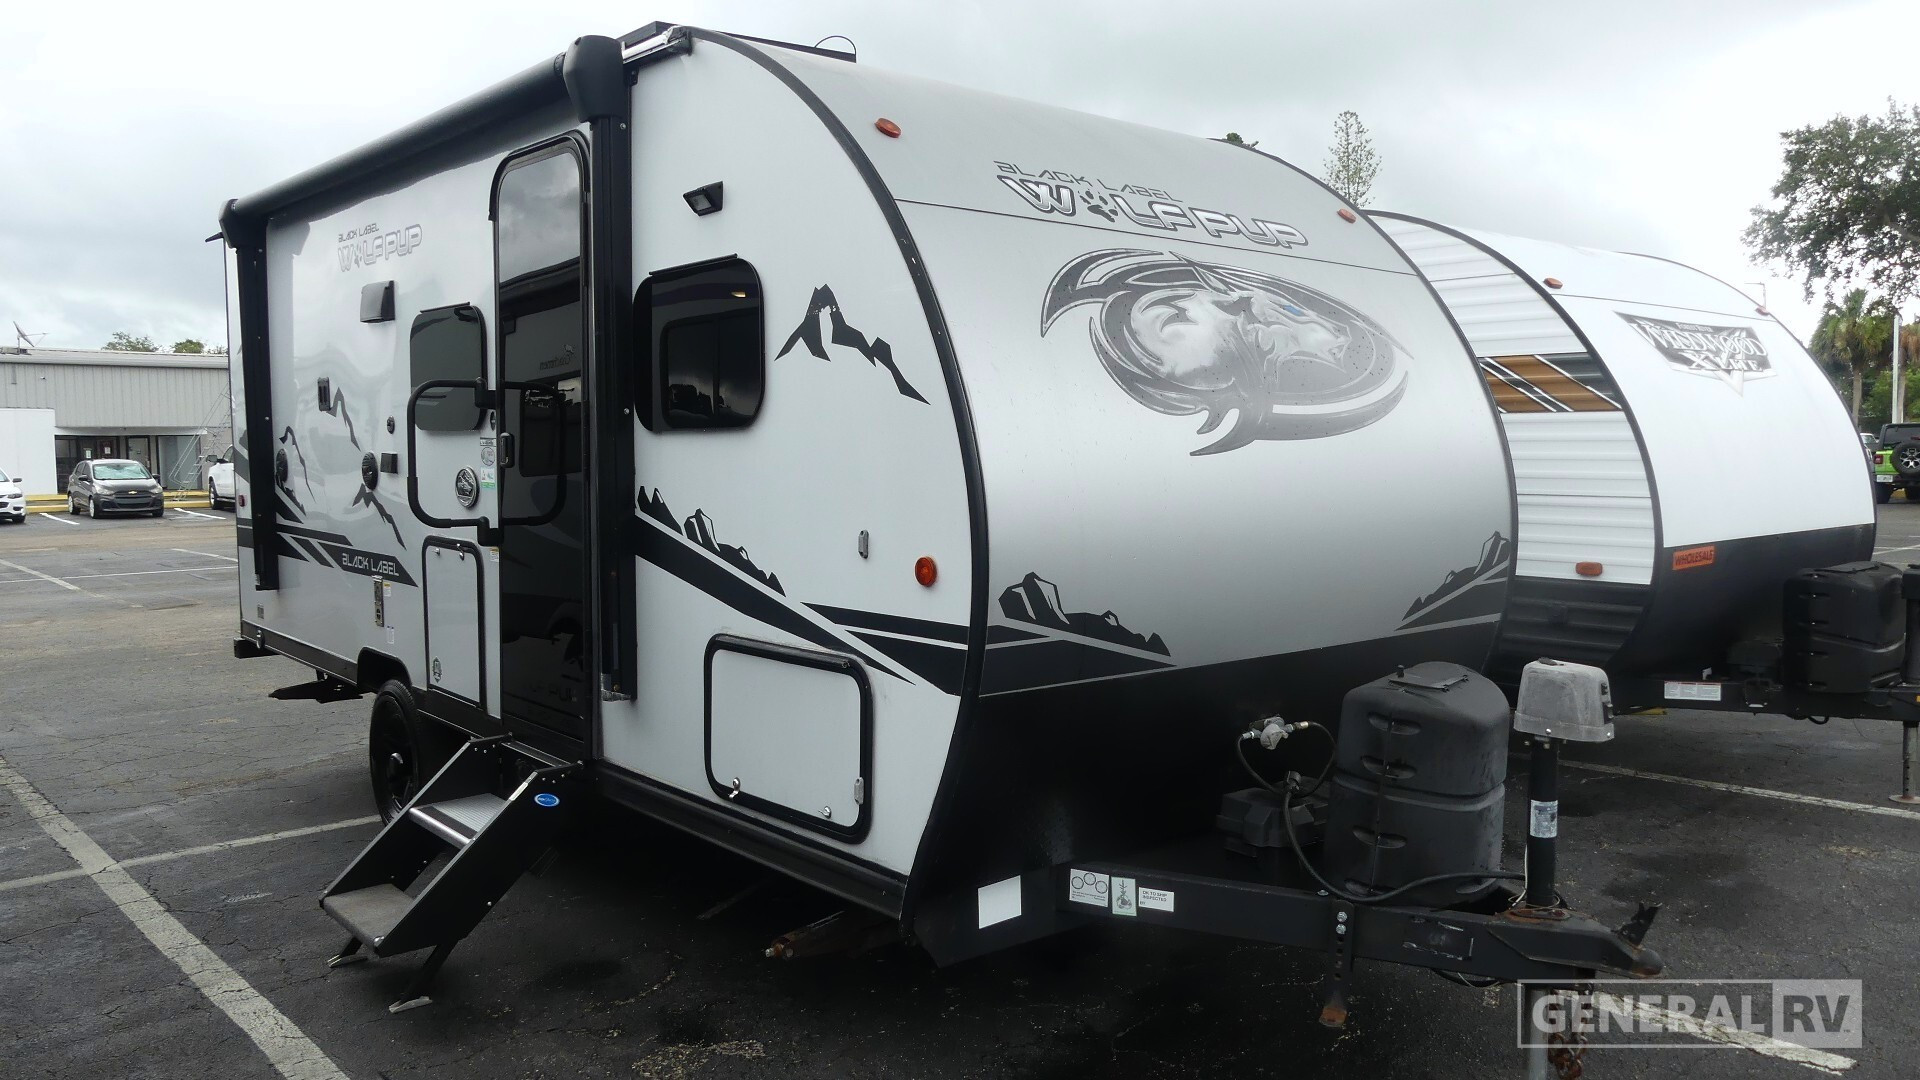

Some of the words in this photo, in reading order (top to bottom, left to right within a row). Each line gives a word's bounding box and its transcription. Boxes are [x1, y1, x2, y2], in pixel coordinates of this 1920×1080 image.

[992, 160, 1093, 187] BLACK
[1097, 178, 1183, 202] LABEL
[338, 229, 357, 243] BLACK
[359, 222, 379, 237] LABEL
[384, 223, 423, 261] PUP
[1187, 206, 1309, 249] PUP
[1629, 317, 1768, 356] WILDWOOD
[342, 553, 369, 569] BLACK
[371, 559, 400, 576] LABEL
[1675, 550, 1713, 566] WHOLESALE
